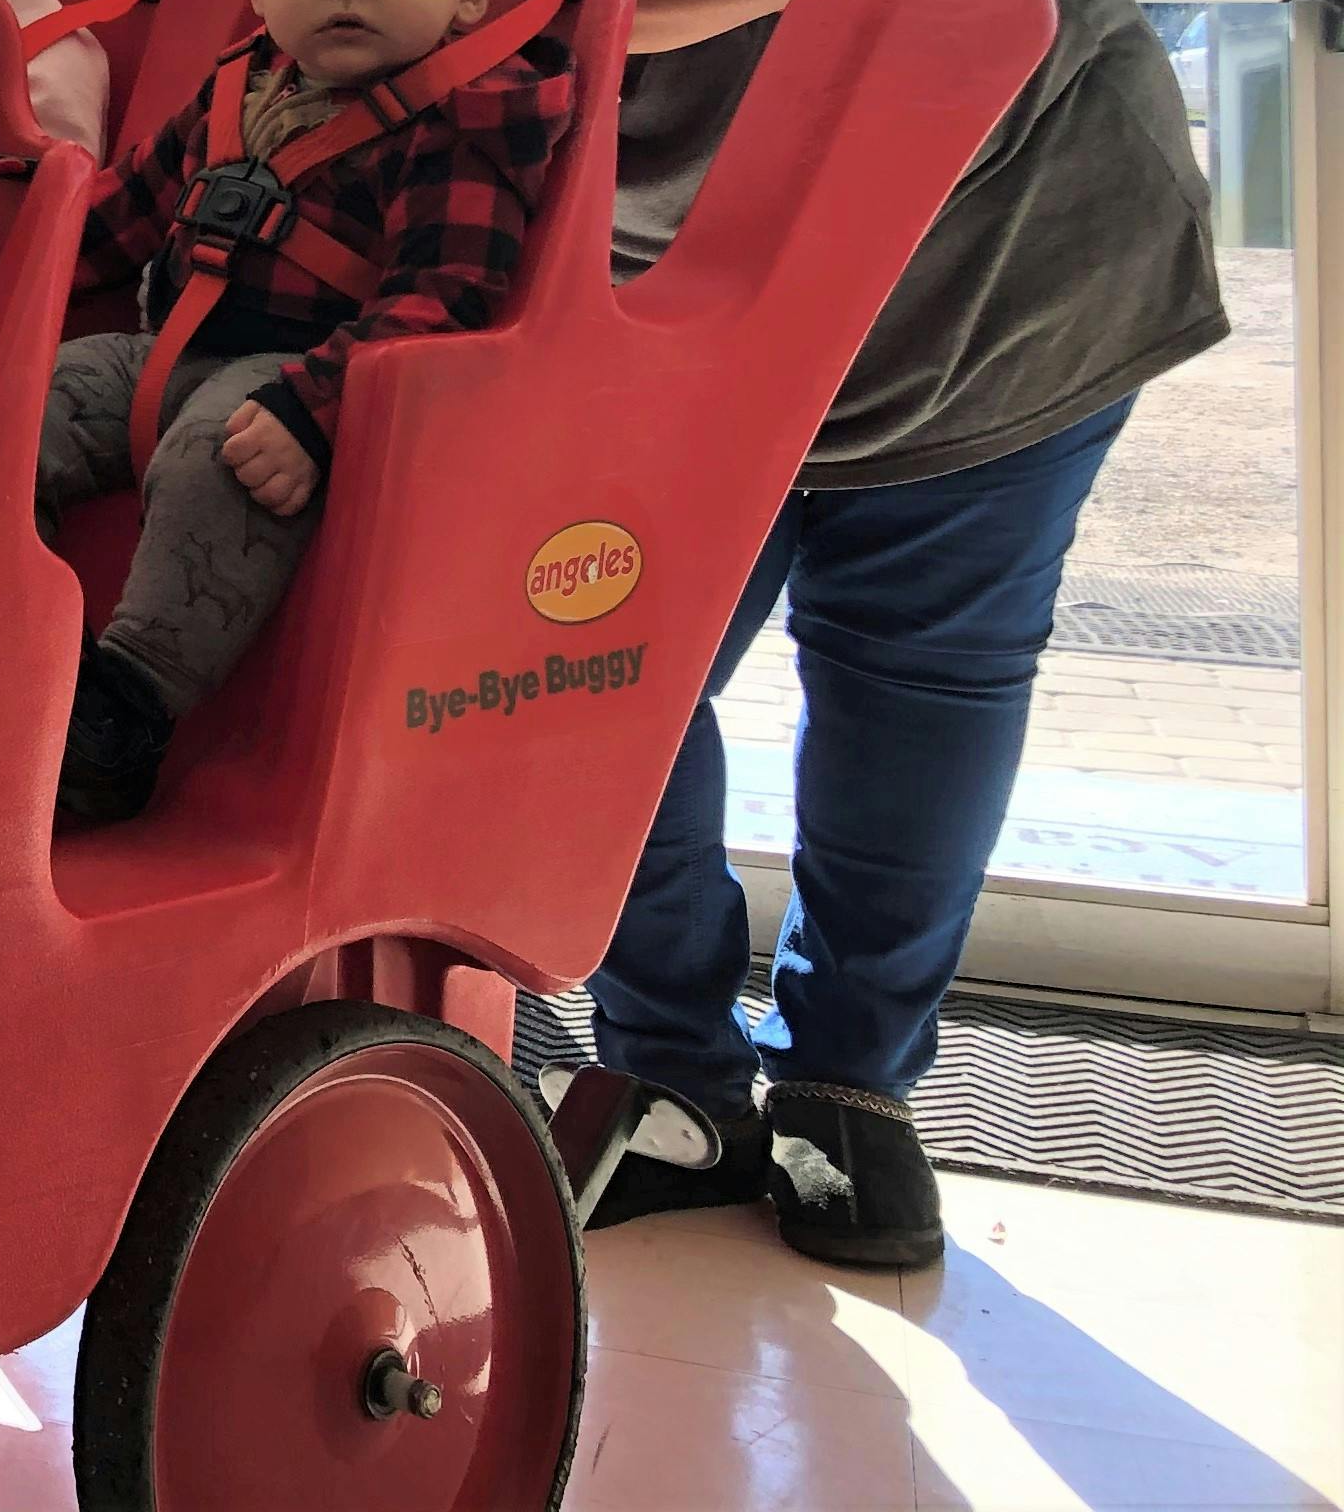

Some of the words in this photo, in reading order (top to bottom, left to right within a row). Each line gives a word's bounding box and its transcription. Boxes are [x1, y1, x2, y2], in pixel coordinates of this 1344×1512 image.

[529, 542, 637, 597] angeles
[405, 670, 540, 733] Bye-Bye
[545, 645, 646, 694] Buggy
